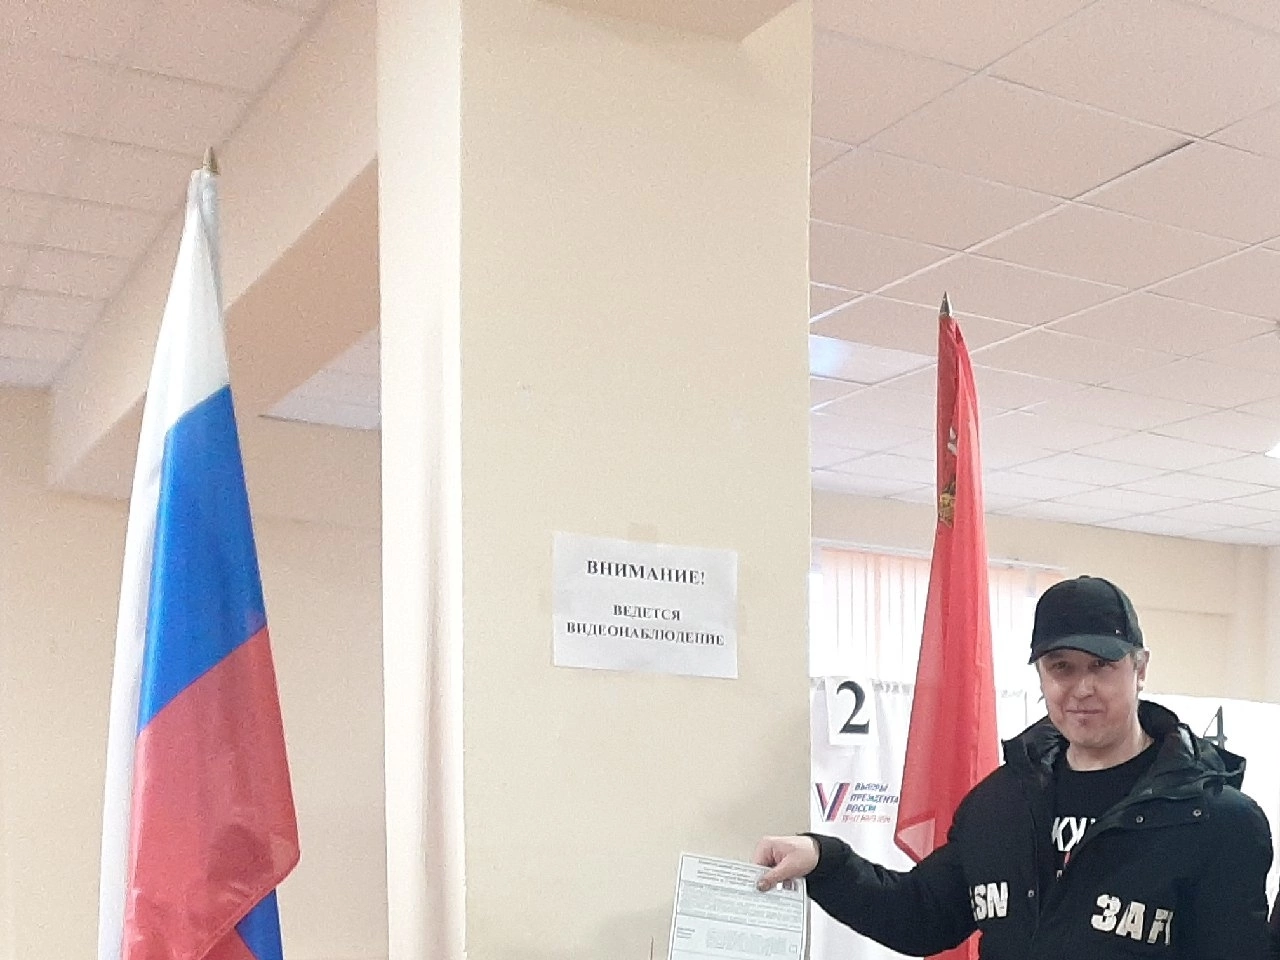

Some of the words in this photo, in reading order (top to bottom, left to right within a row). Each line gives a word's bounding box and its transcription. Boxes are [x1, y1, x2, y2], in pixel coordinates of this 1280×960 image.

[586, 559, 705, 585] ВНИМАНИЕ!
[612, 604, 681, 621] ВЕДЕТСЯ
[566, 621, 725, 646] ВИДЕОНАБЛЮДЕНИЕ
[836, 680, 870, 735] 2
[854, 782, 889, 792] ВЫБОРЫ
[850, 793, 899, 804] ПРЕЗИДЕНТА
[846, 804, 877, 813] РОССИИ
